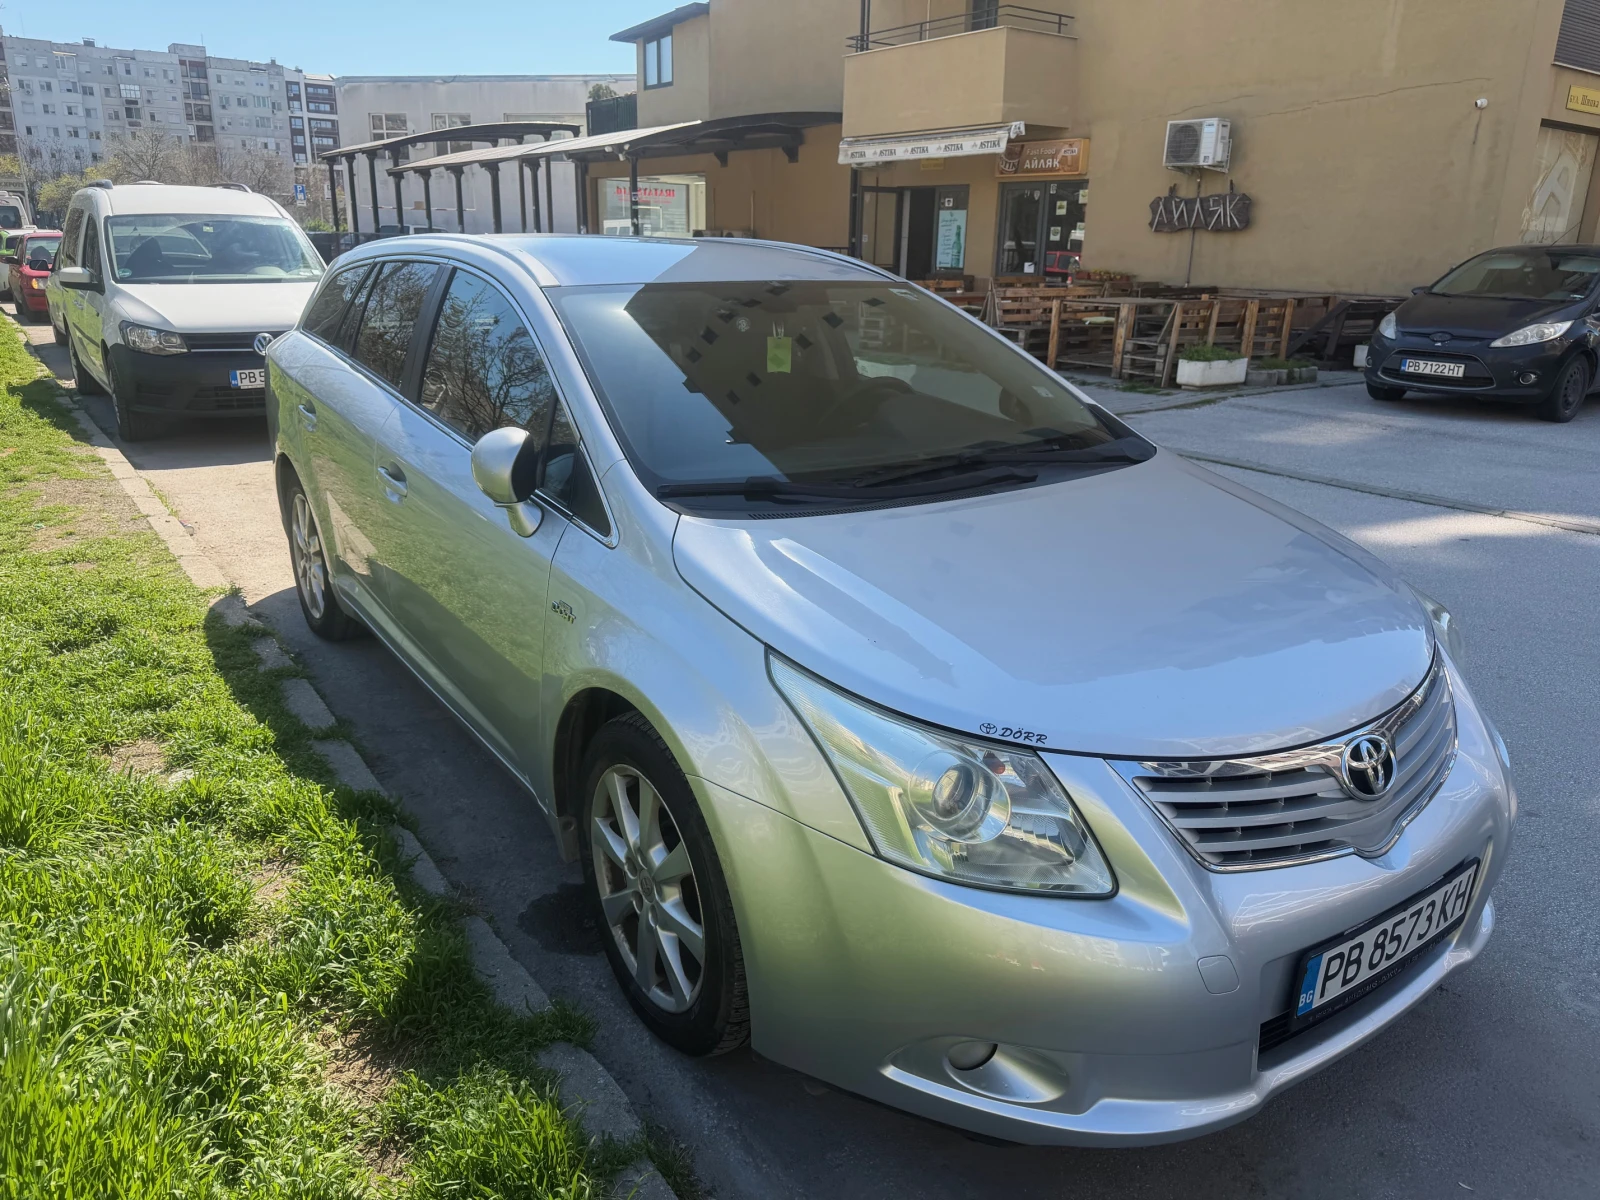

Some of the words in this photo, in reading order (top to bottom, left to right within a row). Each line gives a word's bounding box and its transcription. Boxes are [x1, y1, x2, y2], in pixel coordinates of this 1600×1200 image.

[850, 151, 866, 159] ASTIKA
[878, 149, 897, 157] ASTIKA
[910, 146, 929, 154] ASTIKA
[943, 143, 963, 152] ASTIKA
[979, 139, 1000, 149] ASTIKA
[1040, 147, 1056, 155] Food
[1024, 157, 1060, 169] АЙЛЯК
[297, 185, 303, 193] P
[1407, 360, 1420, 371] PB
[1421, 362, 1446, 374] 7122
[1447, 364, 1463, 376] HT
[239, 371, 257, 384] PB
[998, 727, 1048, 745] DÖRR
[1319, 941, 1365, 999] PB
[1368, 899, 1437, 971] 8573
[1435, 873, 1472, 931] KH
[1299, 990, 1314, 1007] BG
